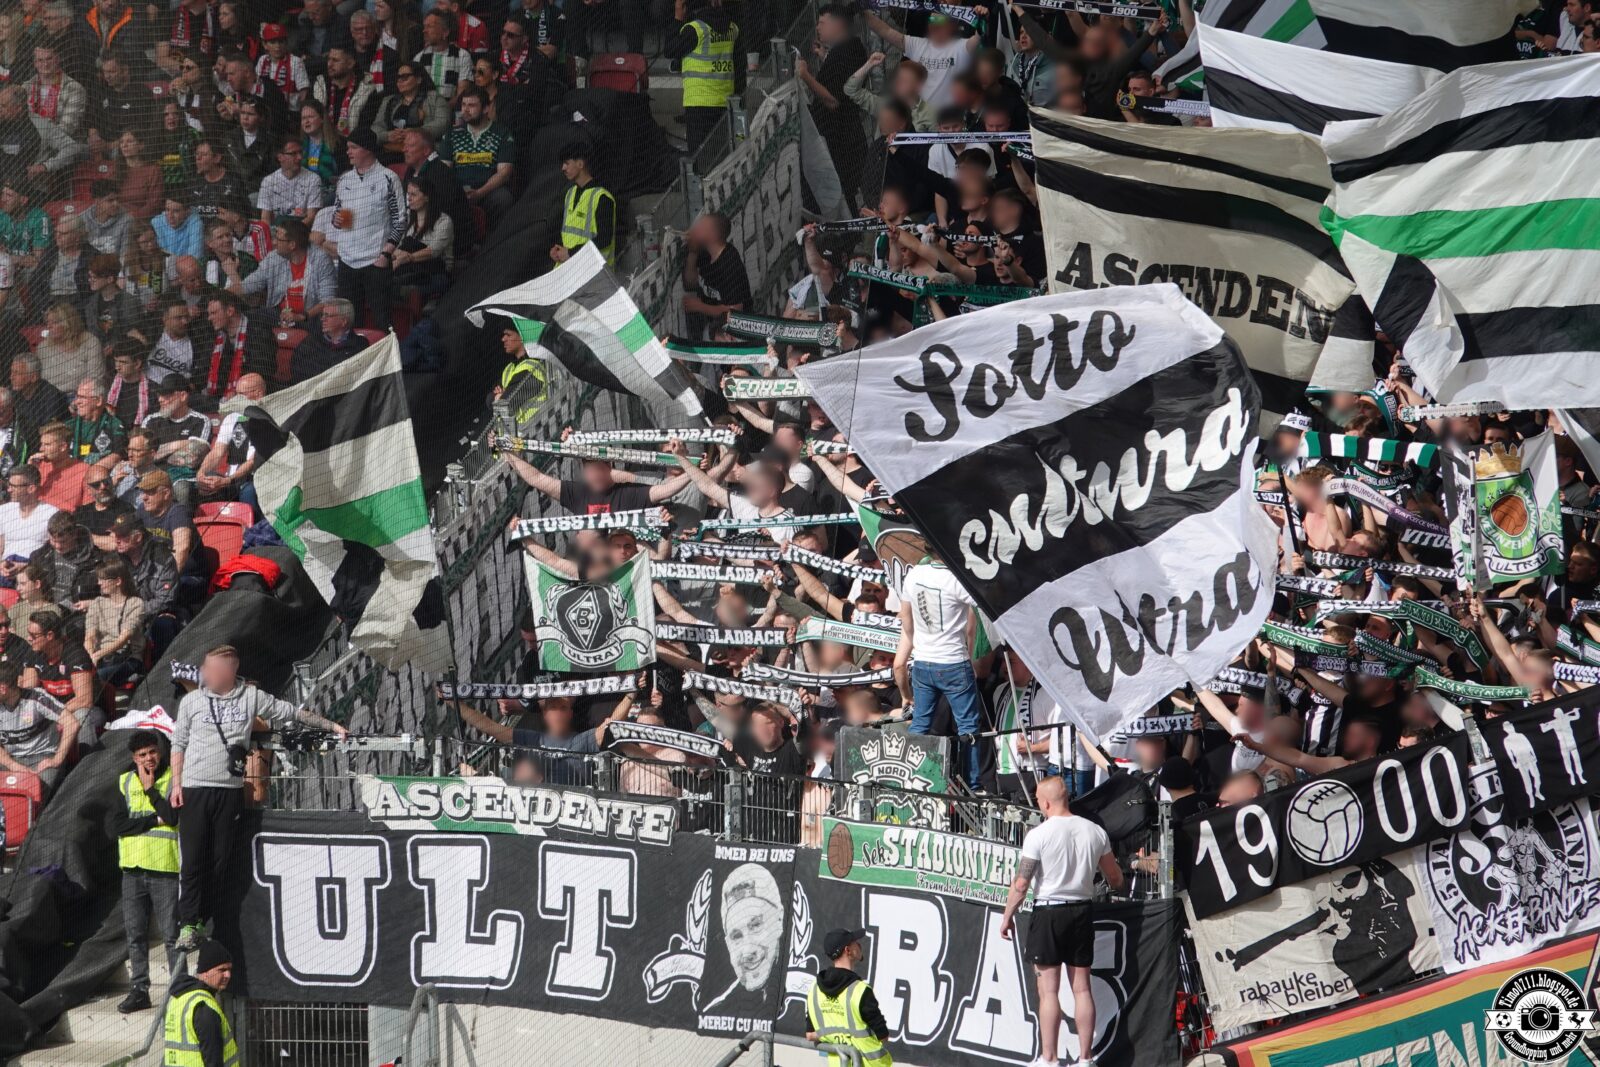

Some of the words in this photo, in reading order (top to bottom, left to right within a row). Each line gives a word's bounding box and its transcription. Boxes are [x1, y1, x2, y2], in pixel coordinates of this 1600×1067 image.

[1111, 6, 1139, 16] 1900
[711, 61, 733, 73] 3026
[1016, 150, 1035, 161] VOL
[893, 310, 1136, 443] Sotto
[441, 674, 637, 700] SOTTOCULTURA
[877, 766, 908, 780] NORD
[369, 781, 676, 847] ASCENDENTE
[748, 848, 769, 862] BEI
[769, 848, 796, 863] UNS
[882, 826, 1022, 888] STADIONVER
[1238, 971, 1318, 1003] rabauke
[698, 1015, 736, 1031] MEREU
[735, 1018, 752, 1033] CU
